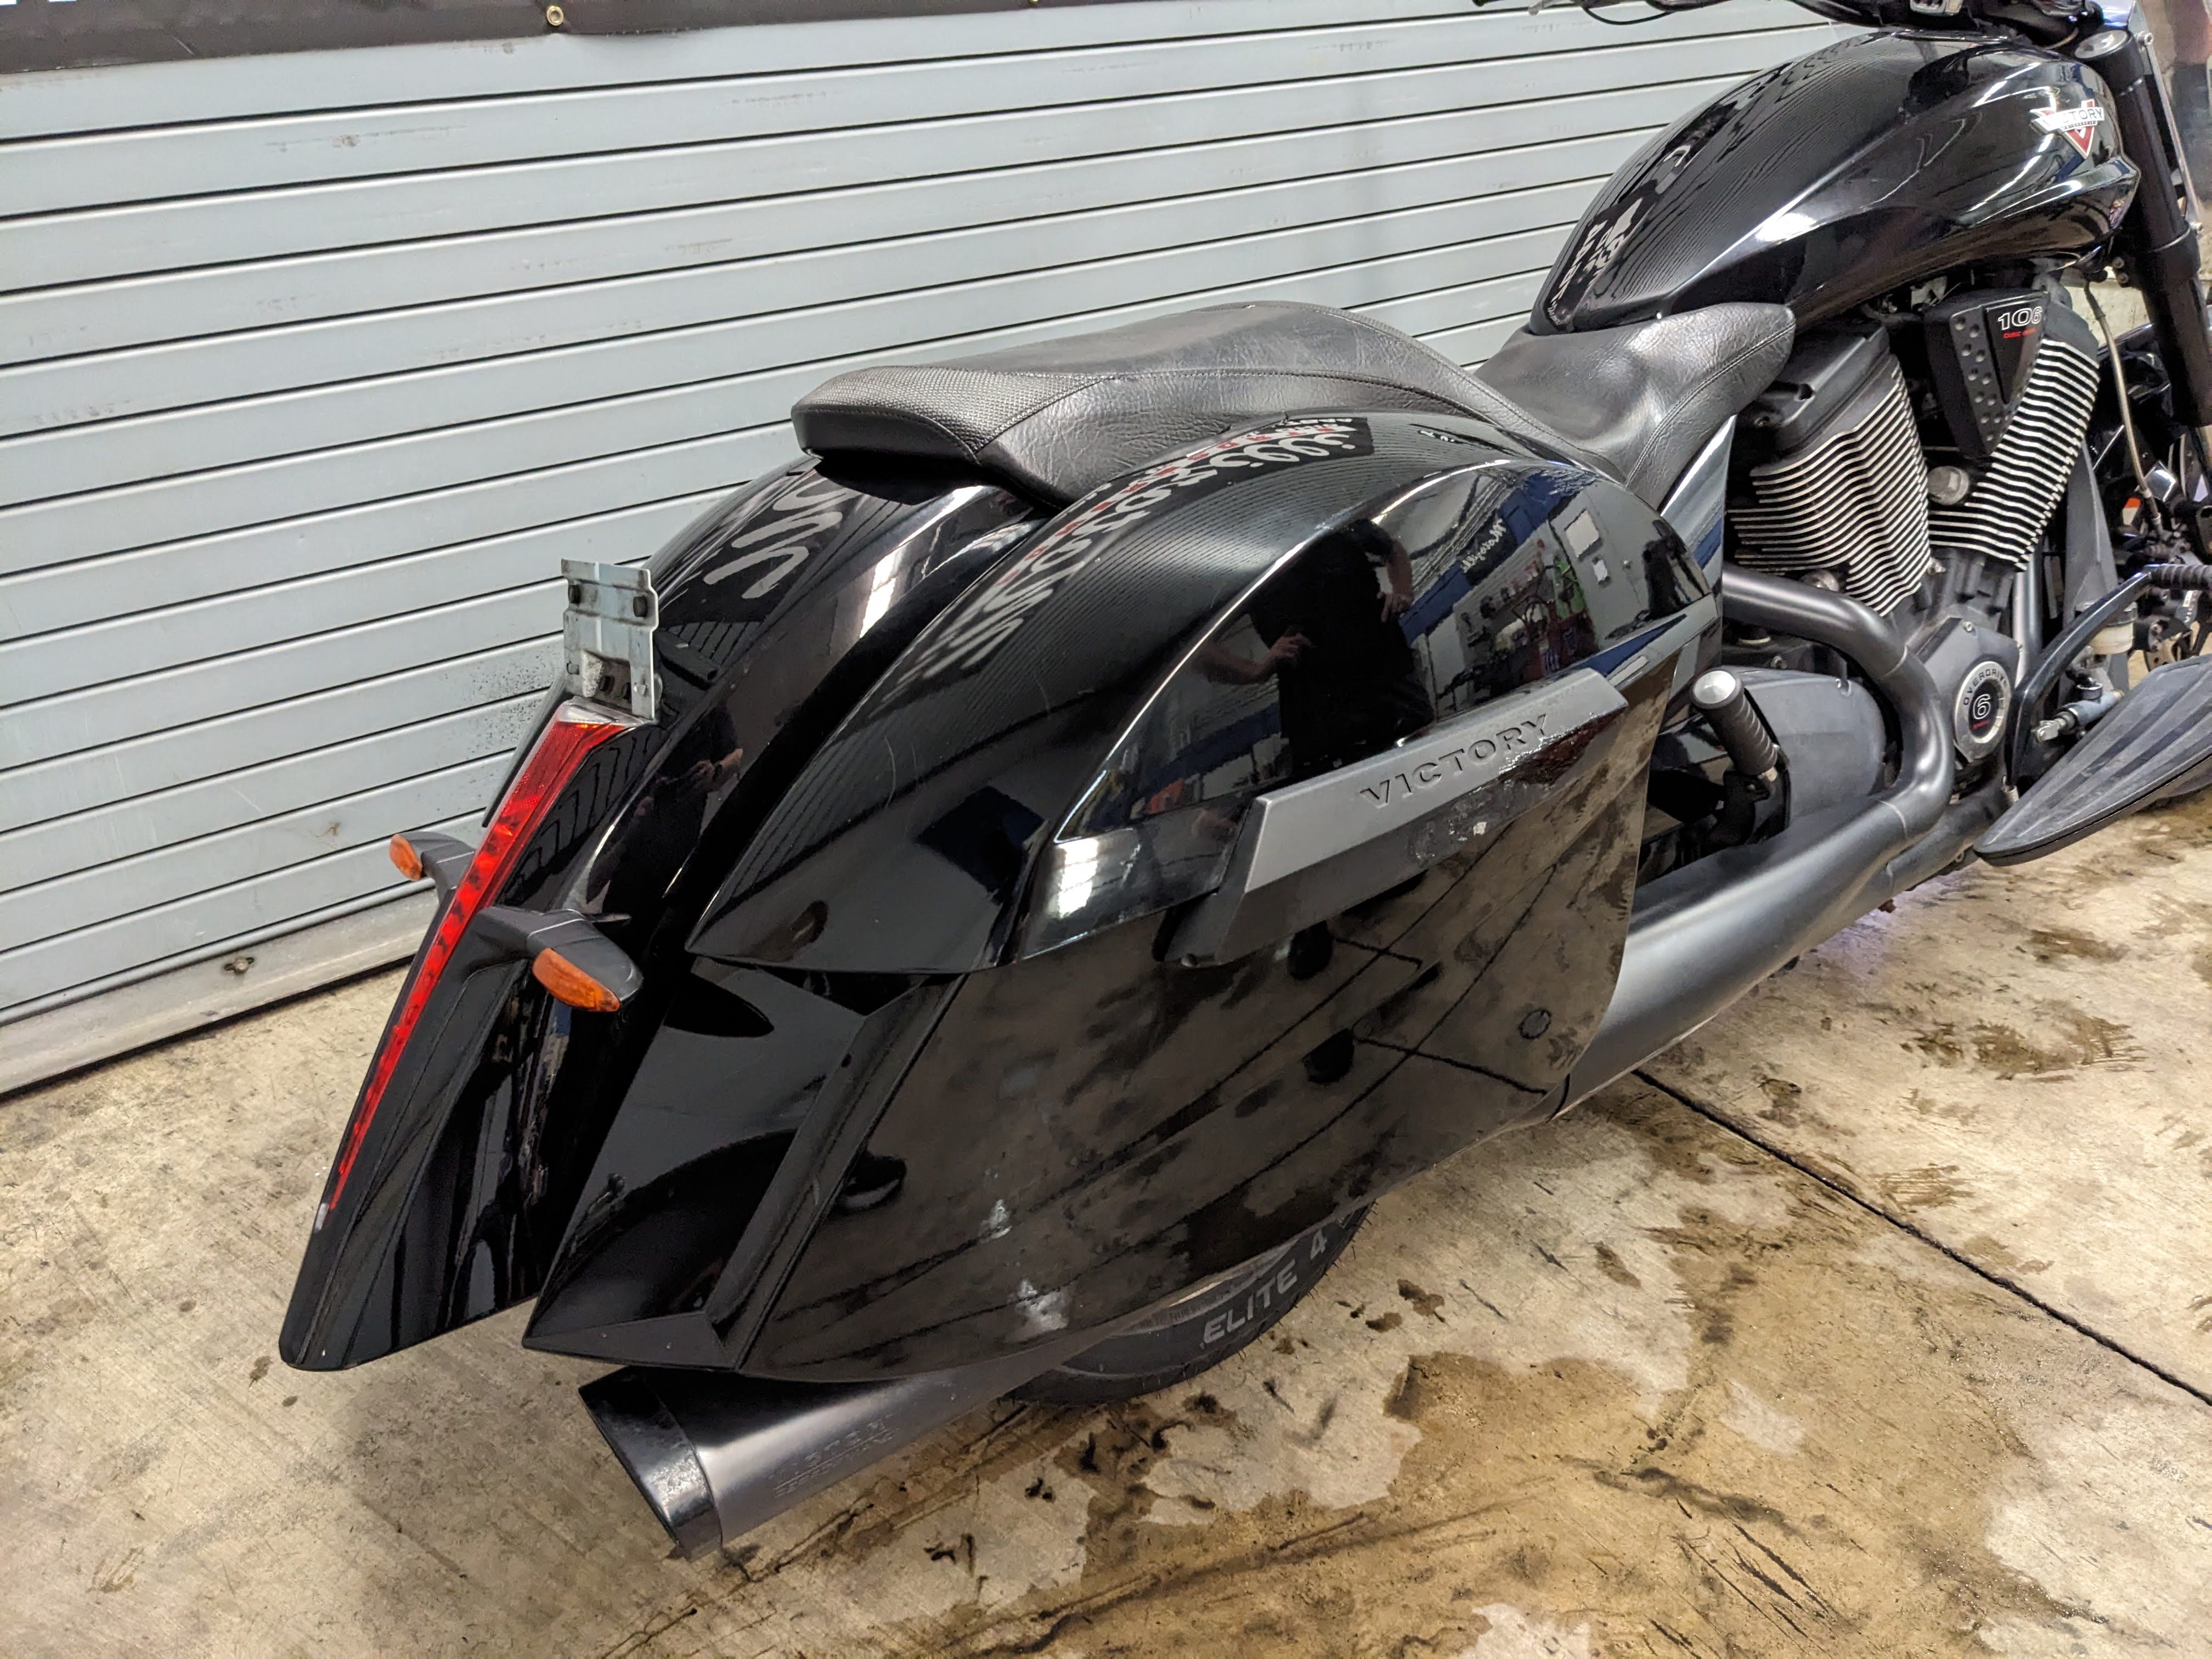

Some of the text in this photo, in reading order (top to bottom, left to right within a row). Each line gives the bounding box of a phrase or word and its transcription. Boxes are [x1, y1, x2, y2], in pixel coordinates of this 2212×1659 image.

[2042, 108, 2102, 127] VCTORY
[1997, 306, 2042, 330] 106
[1973, 694, 1991, 719] 6
[1360, 713, 1547, 809] VICTORY
[1203, 1259, 1298, 1344] ELITE
[1310, 1229, 1328, 1259] 4
